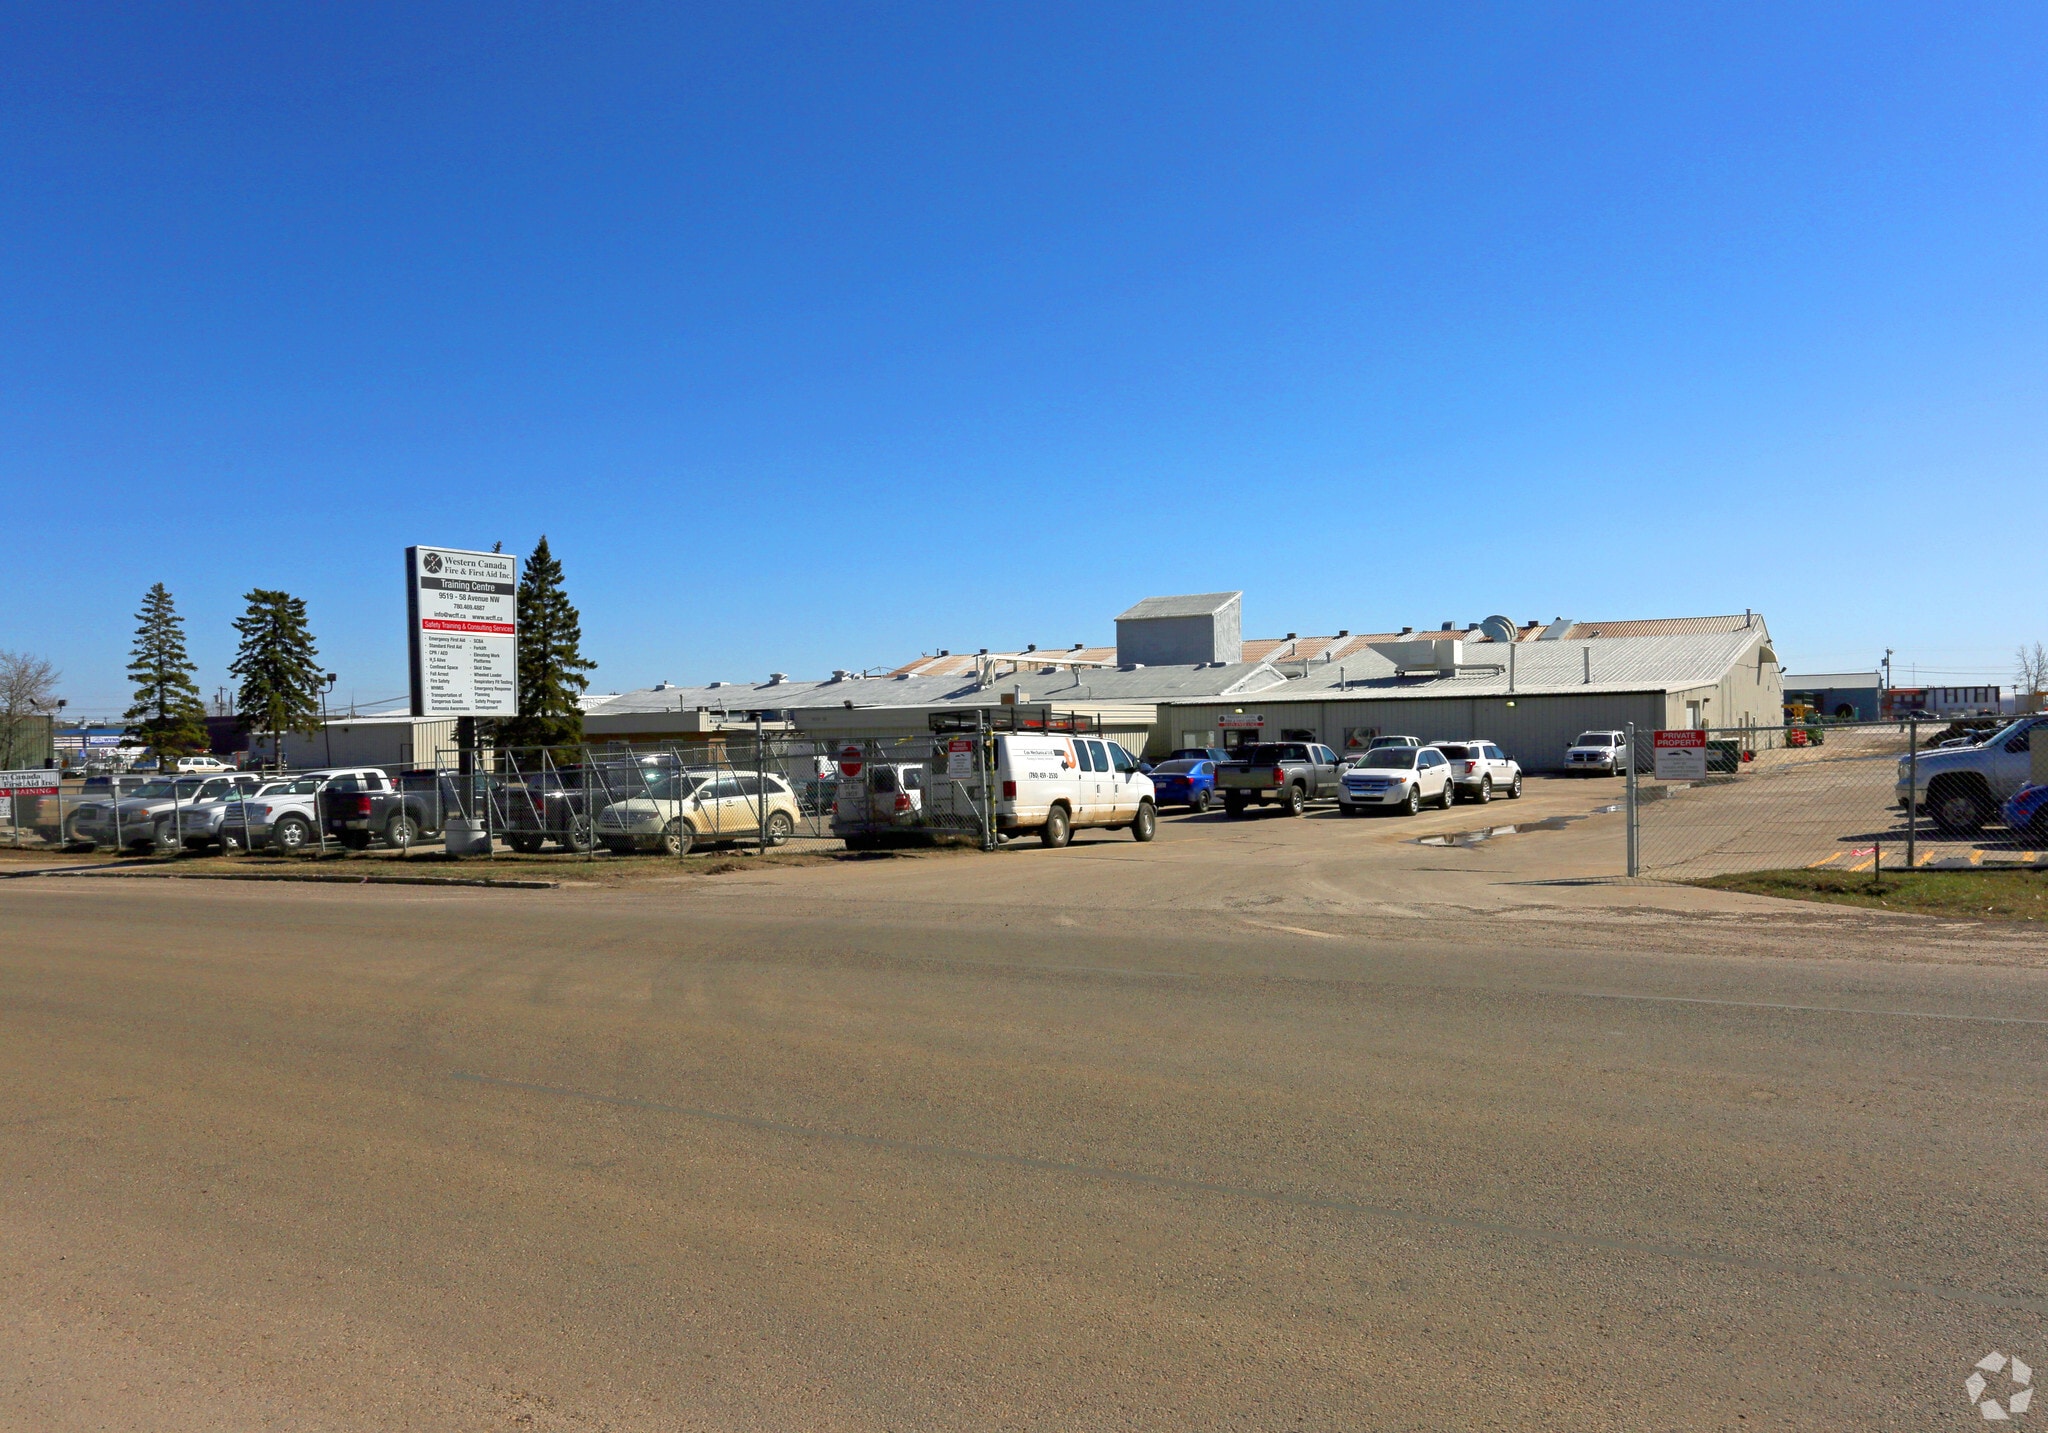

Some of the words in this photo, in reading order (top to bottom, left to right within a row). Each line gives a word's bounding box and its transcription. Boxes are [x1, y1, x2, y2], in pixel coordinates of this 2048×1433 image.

[445, 557, 476, 567] Western
[478, 560, 507, 570] Canada
[441, 579, 470, 591] Training
[472, 582, 495, 592] Centre
